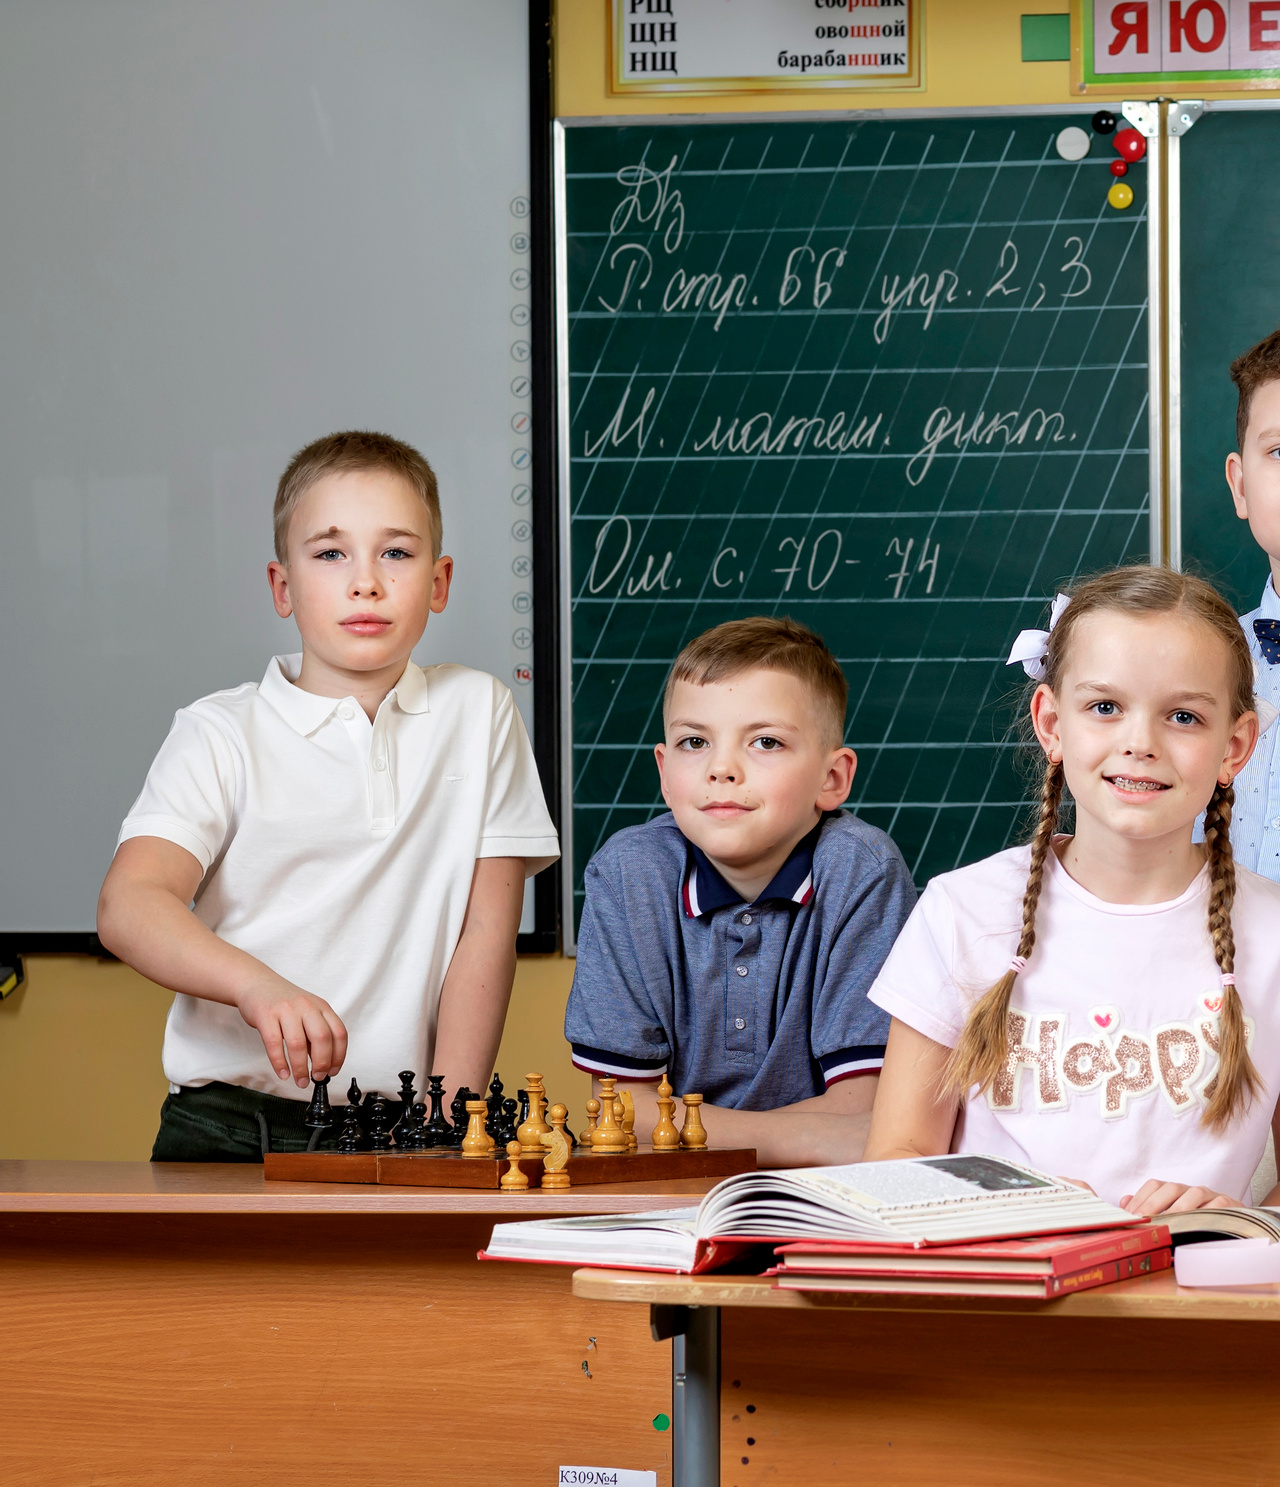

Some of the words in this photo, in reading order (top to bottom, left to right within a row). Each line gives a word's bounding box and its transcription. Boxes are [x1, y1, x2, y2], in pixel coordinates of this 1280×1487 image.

[629, 22, 677, 47] ЩН
[815, 20, 906, 39] овощной
[1108, 1, 1149, 56] Я
[1169, 0, 1227, 53] Ю
[629, 51, 678, 76] НЩ
[777, 49, 906, 73] барабанщик
[663, 268, 758, 332] стр.
[873, 269, 972, 344] упр.
[1061, 236, 1092, 297] 3
[694, 411, 891, 454] матем.
[905, 405, 1078, 486] дикт.
[559, 1470, 618, 1486] К309№4
